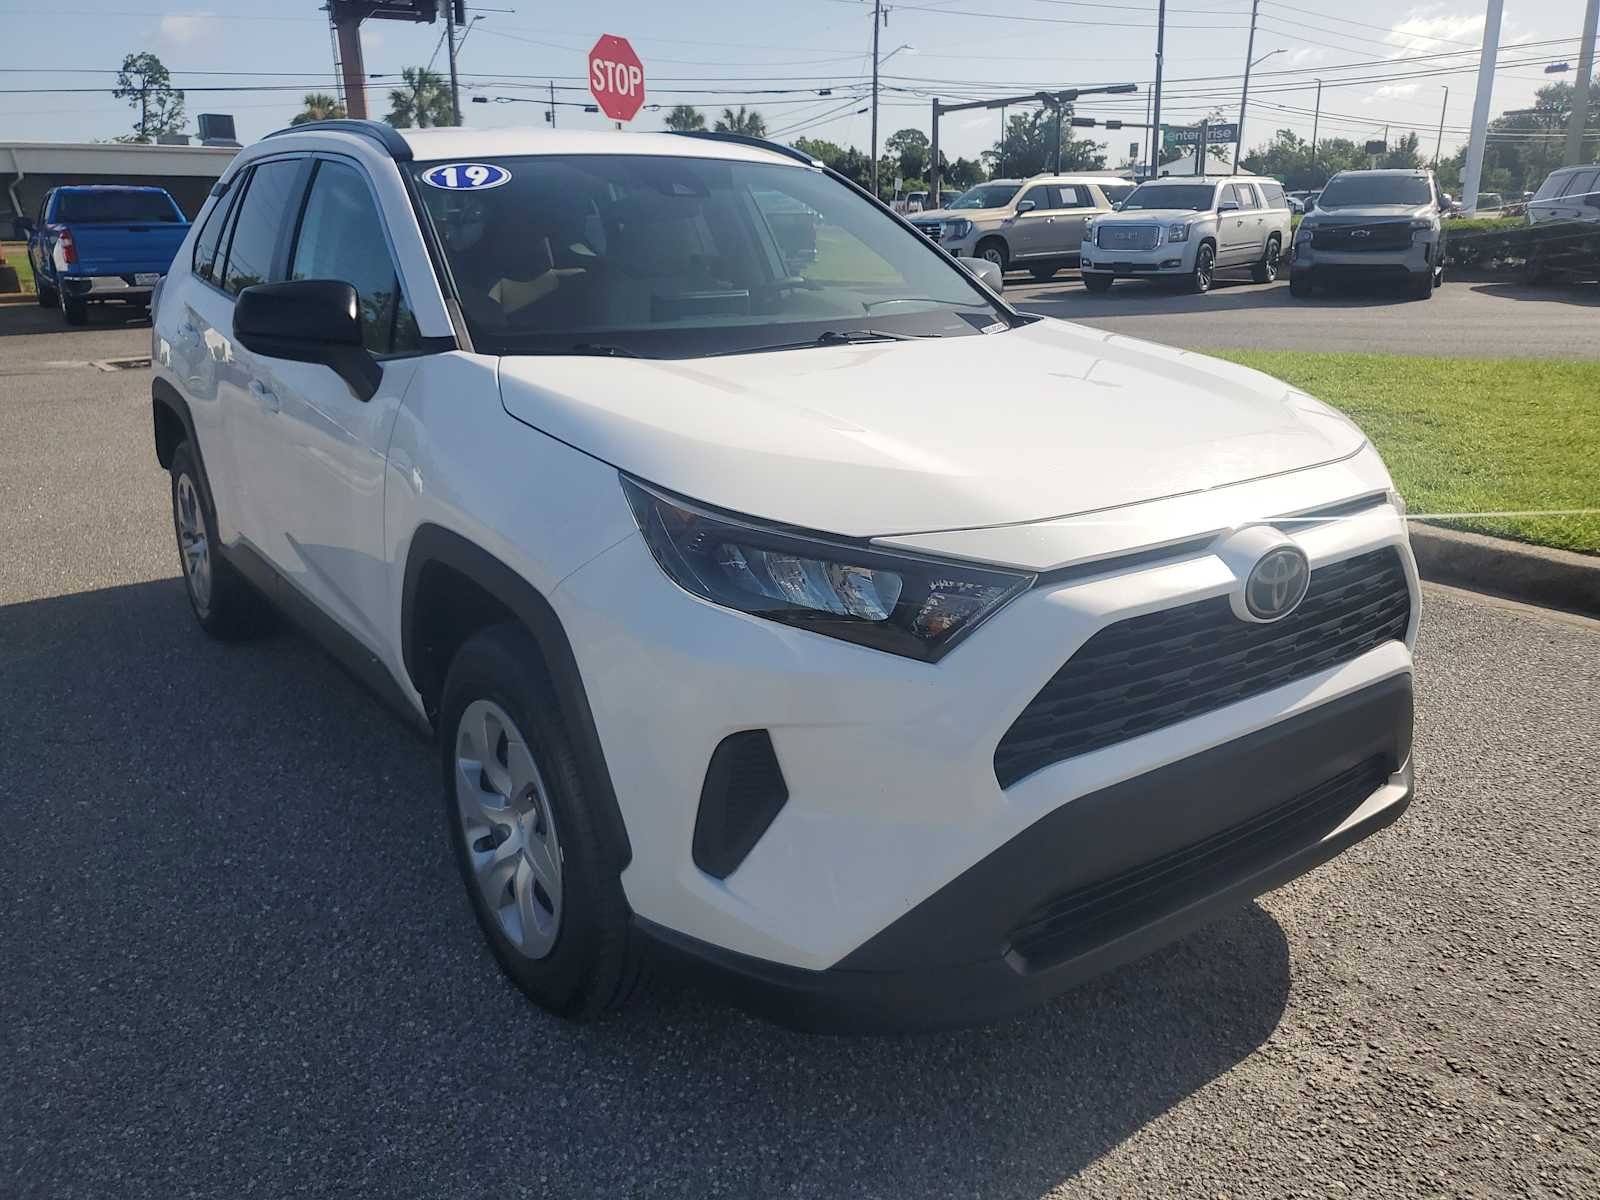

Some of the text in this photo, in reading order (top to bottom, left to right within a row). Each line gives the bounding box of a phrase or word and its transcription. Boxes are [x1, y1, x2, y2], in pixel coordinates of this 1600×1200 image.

[592, 58, 642, 97] STOP
[1167, 127, 1232, 142] enterrise
[441, 166, 490, 187] 19
